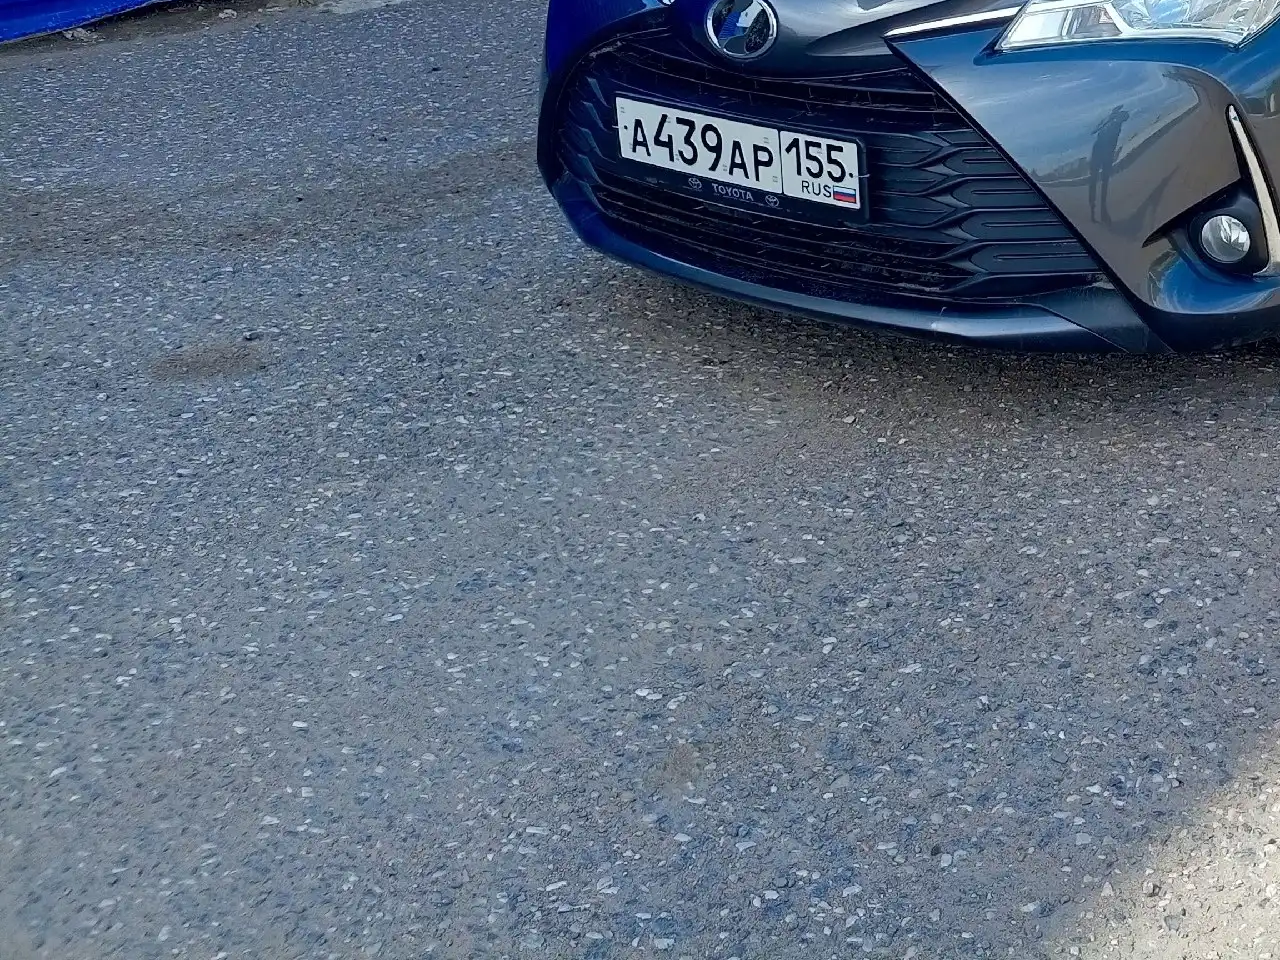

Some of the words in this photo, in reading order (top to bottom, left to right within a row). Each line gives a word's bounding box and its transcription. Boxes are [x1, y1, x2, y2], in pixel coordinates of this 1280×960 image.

[785, 137, 846, 183] 155
[712, 183, 754, 202] TOYOTA
[801, 180, 832, 198] RUS
